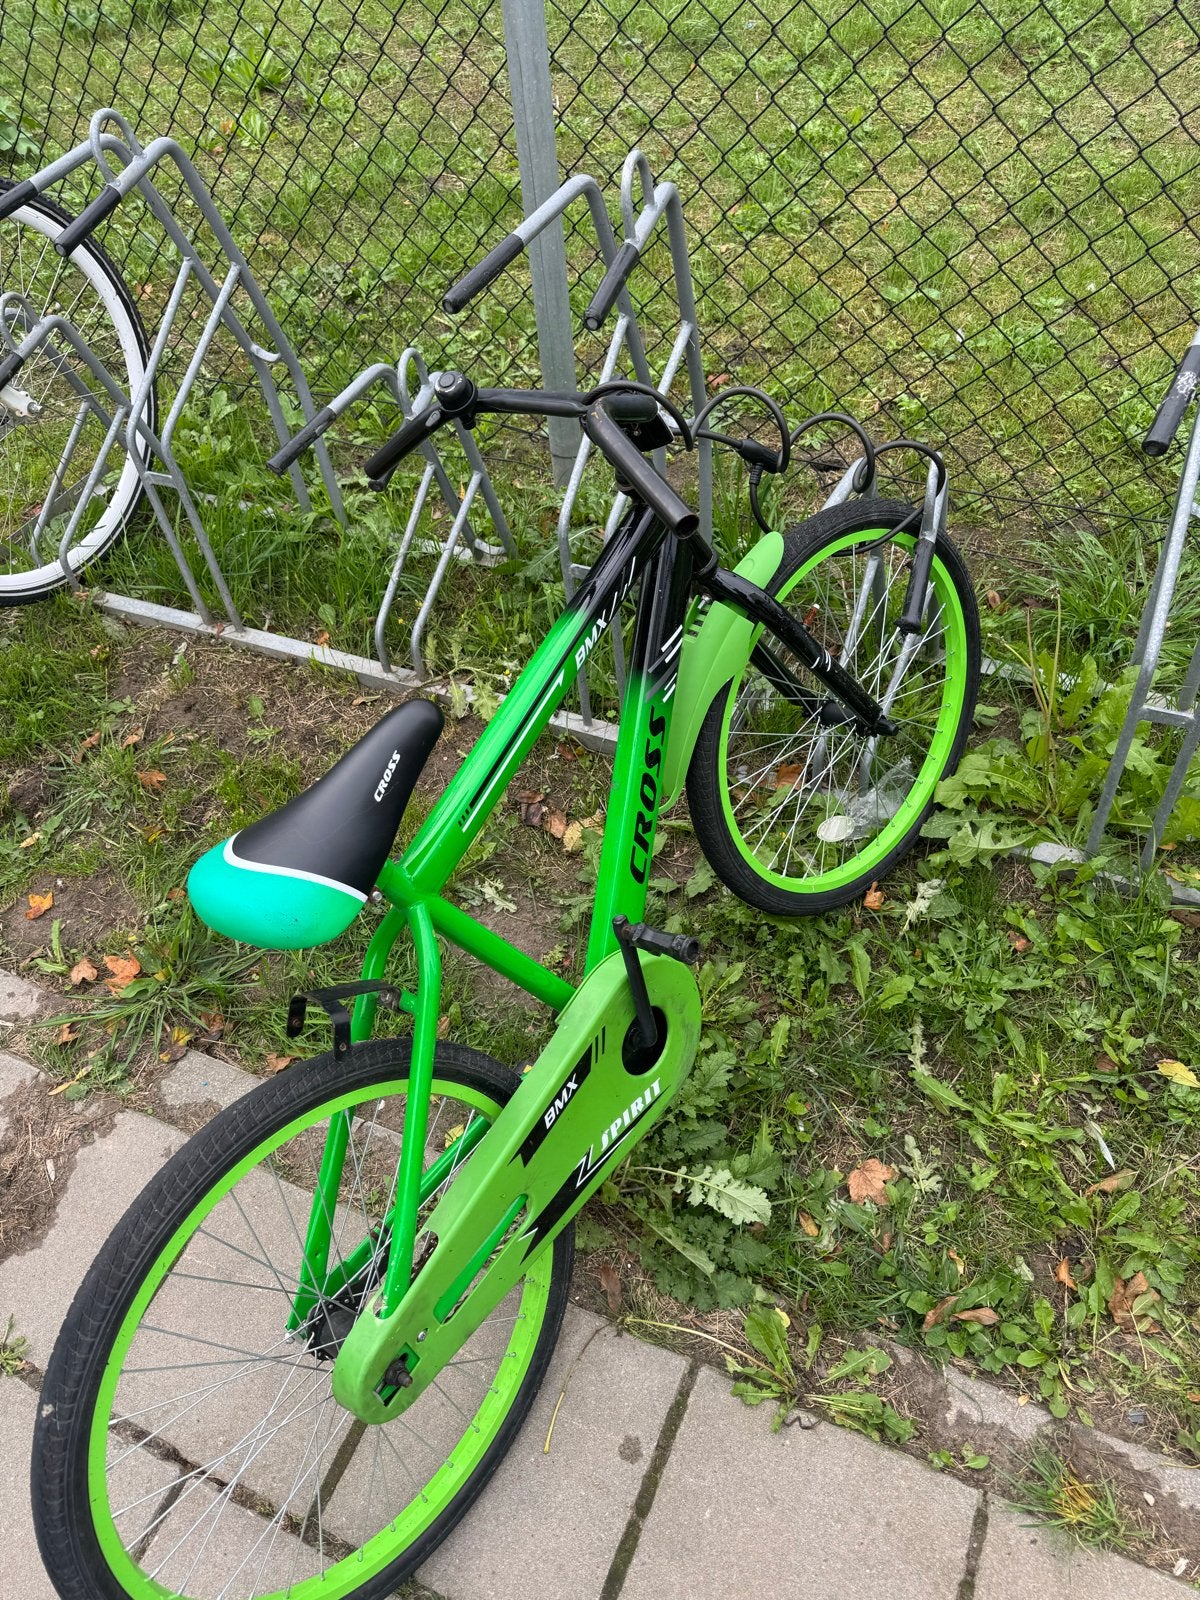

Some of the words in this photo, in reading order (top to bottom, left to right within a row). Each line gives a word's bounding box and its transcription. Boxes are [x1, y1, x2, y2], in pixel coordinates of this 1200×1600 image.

[575, 609, 607, 671] BMX
[374, 750, 400, 802] CROSS
[630, 705, 666, 885] CROSS
[544, 1073, 578, 1130] BMX
[601, 1077, 661, 1151] SPIRIT
